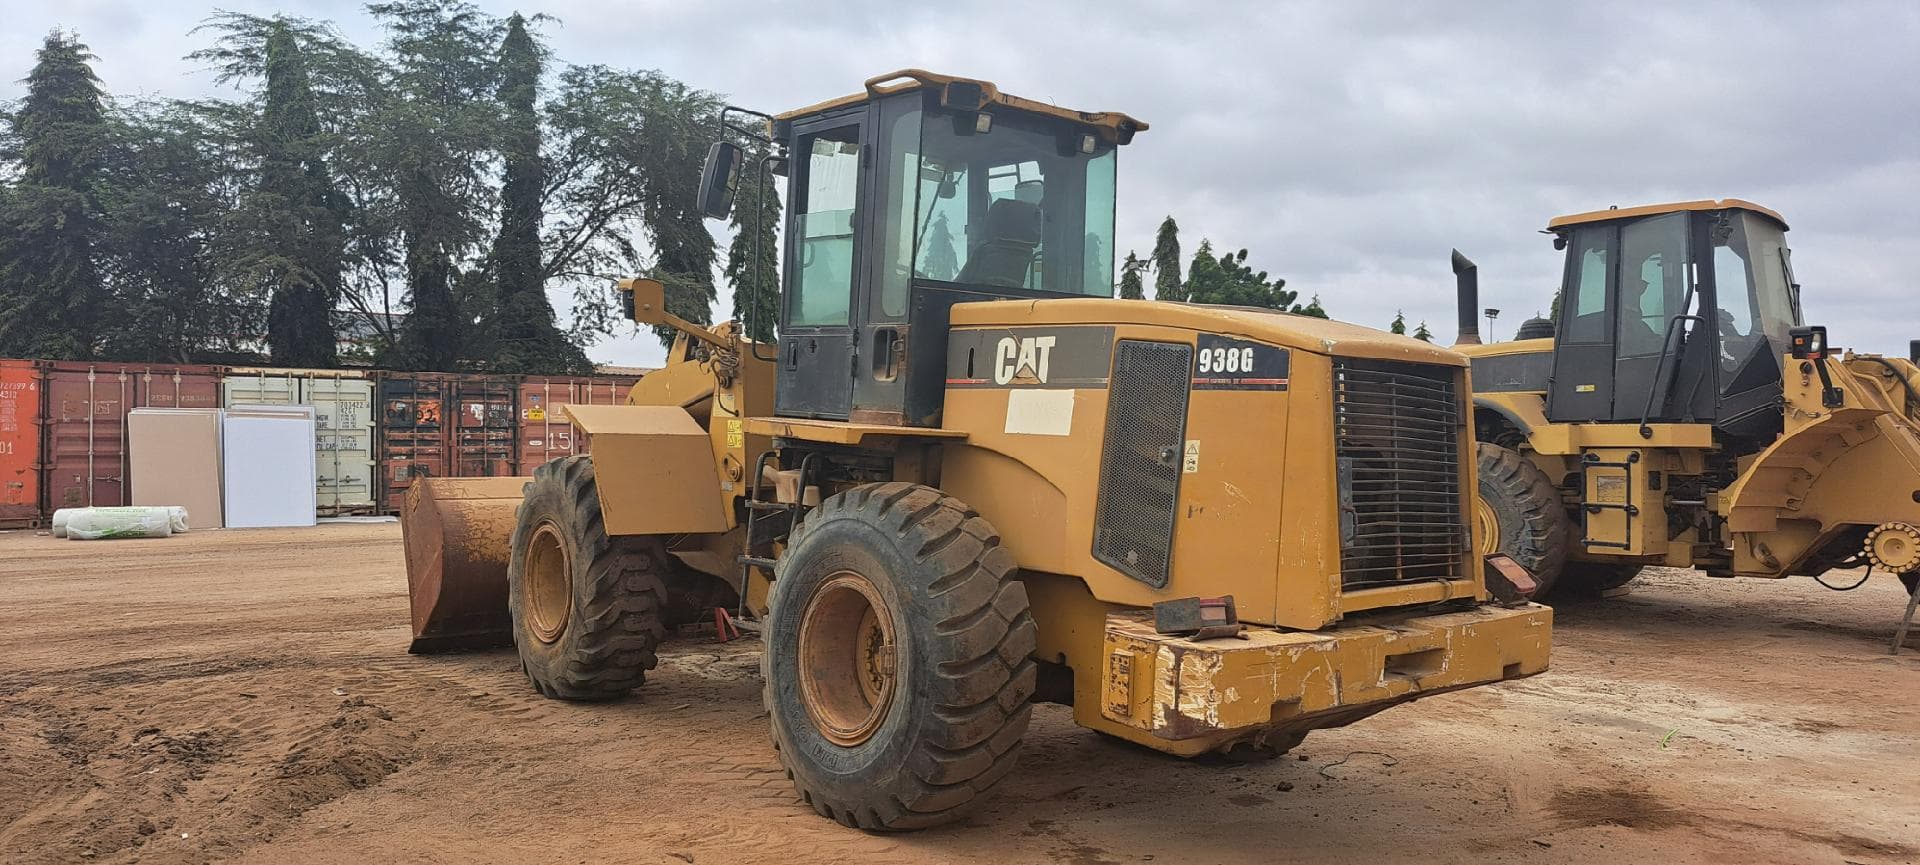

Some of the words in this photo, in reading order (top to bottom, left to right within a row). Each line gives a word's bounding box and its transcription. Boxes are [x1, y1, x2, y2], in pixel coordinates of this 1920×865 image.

[995, 336, 1056, 385] CAT
[1199, 347, 1254, 373] 938G
[549, 432, 571, 450] 15
